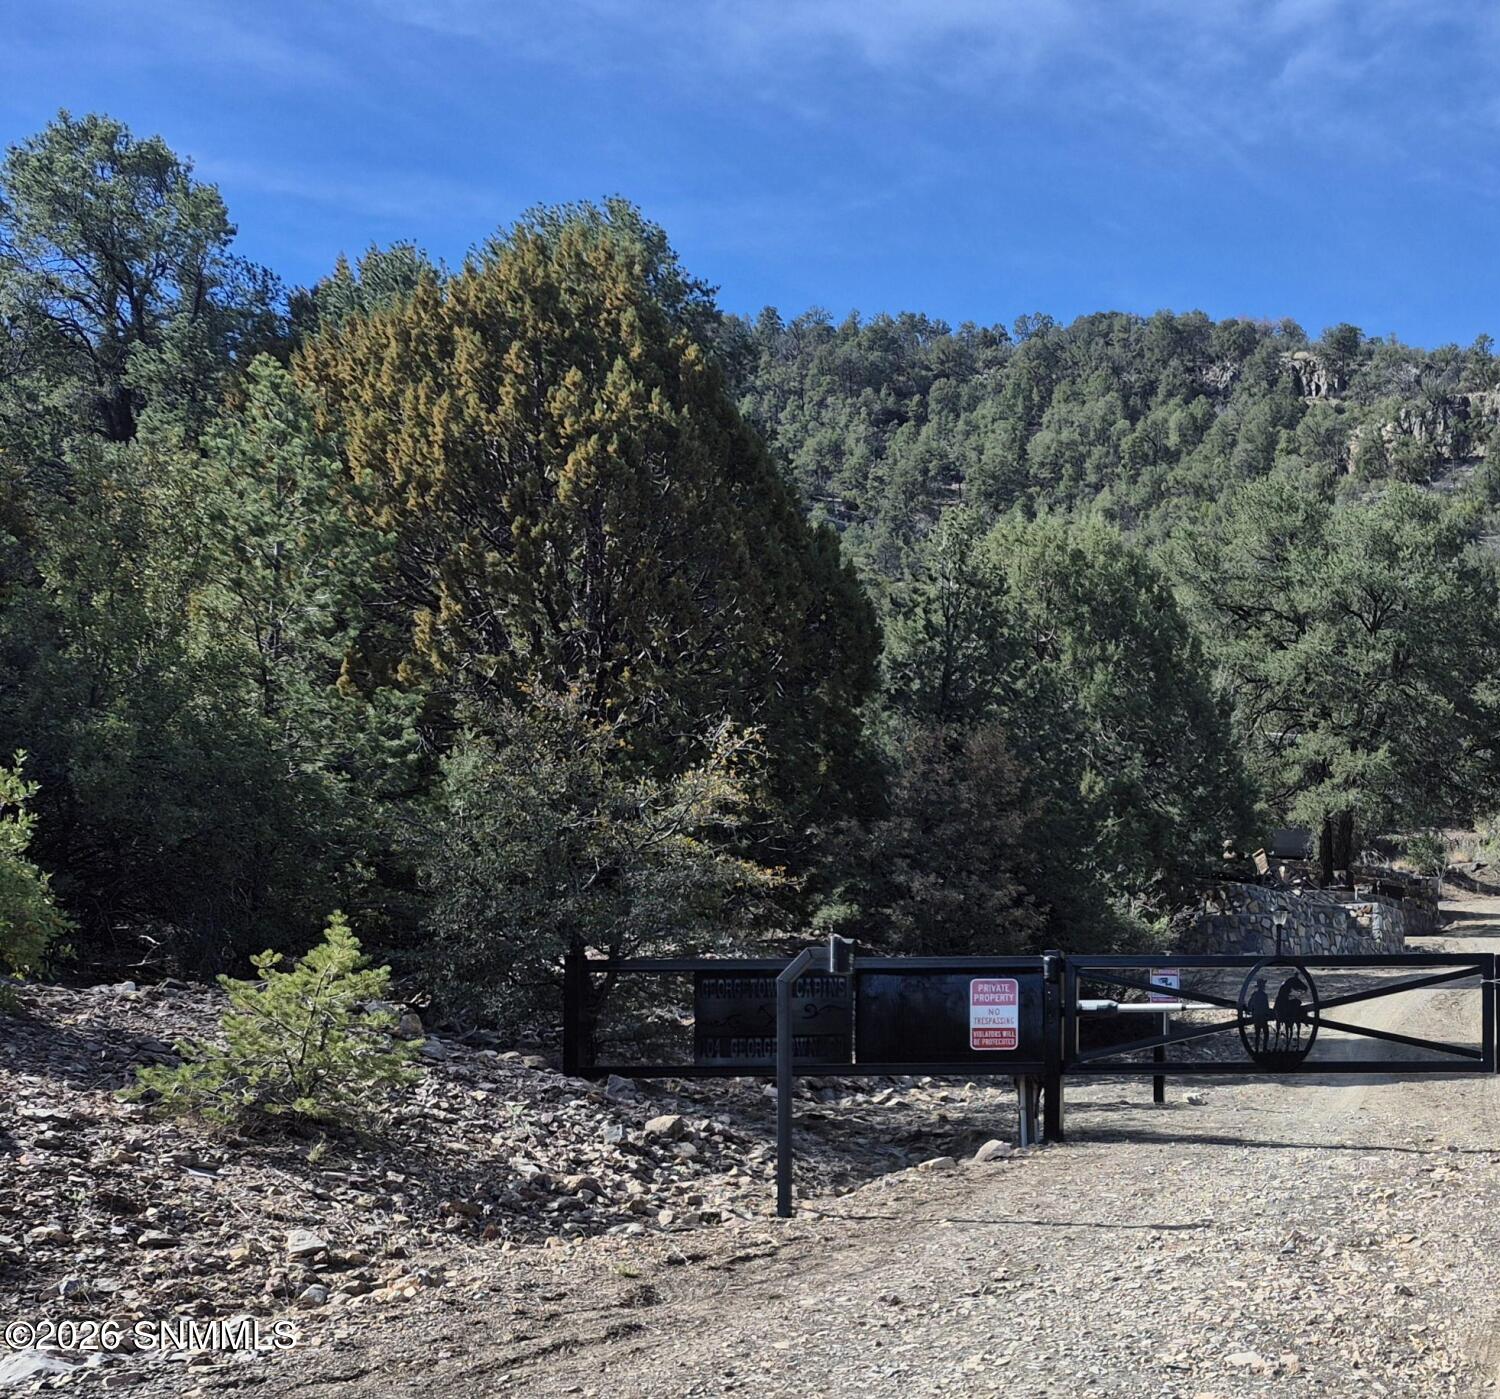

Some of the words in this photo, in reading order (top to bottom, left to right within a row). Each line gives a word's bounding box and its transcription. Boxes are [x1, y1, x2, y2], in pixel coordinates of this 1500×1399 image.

[702, 977, 785, 998] GEORGETOW
[796, 977, 847, 998] CABINS
[977, 984, 1010, 992] PRIVATE
[974, 993, 1014, 1002] PROPERTY
[988, 1008, 1000, 1016] NO
[974, 1017, 1015, 1025] TRESPASSING
[973, 1030, 1000, 1038] VIOLATORS
[1002, 1030, 1016, 1038] WILL
